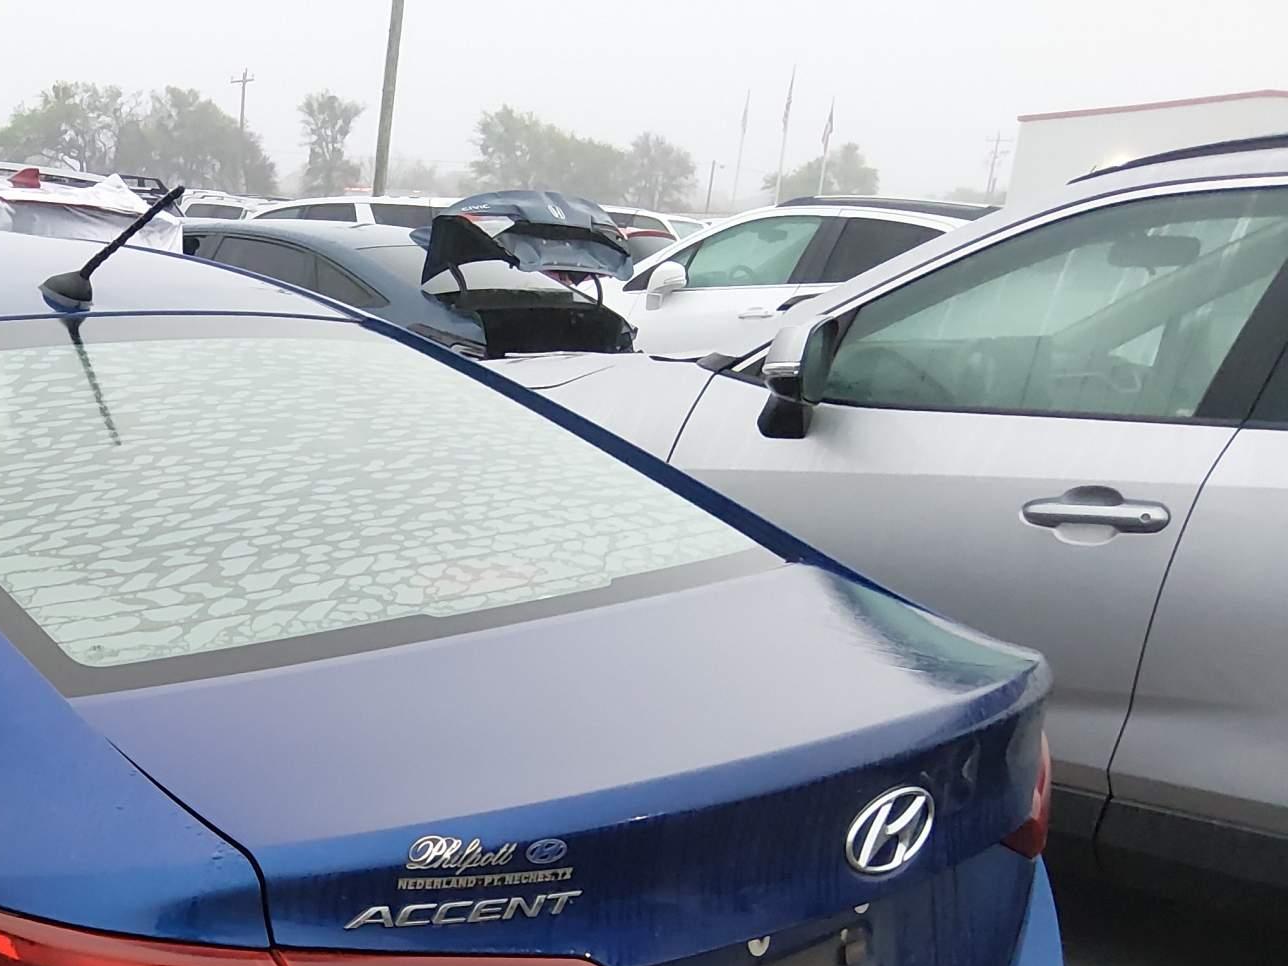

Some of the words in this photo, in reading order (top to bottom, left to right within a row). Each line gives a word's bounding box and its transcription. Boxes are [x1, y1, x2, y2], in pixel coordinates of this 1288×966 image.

[460, 203, 491, 212] CIVIC
[406, 835, 518, 875] Philpott
[397, 876, 476, 890] NEDERLAND
[343, 890, 583, 929] ACCENT
